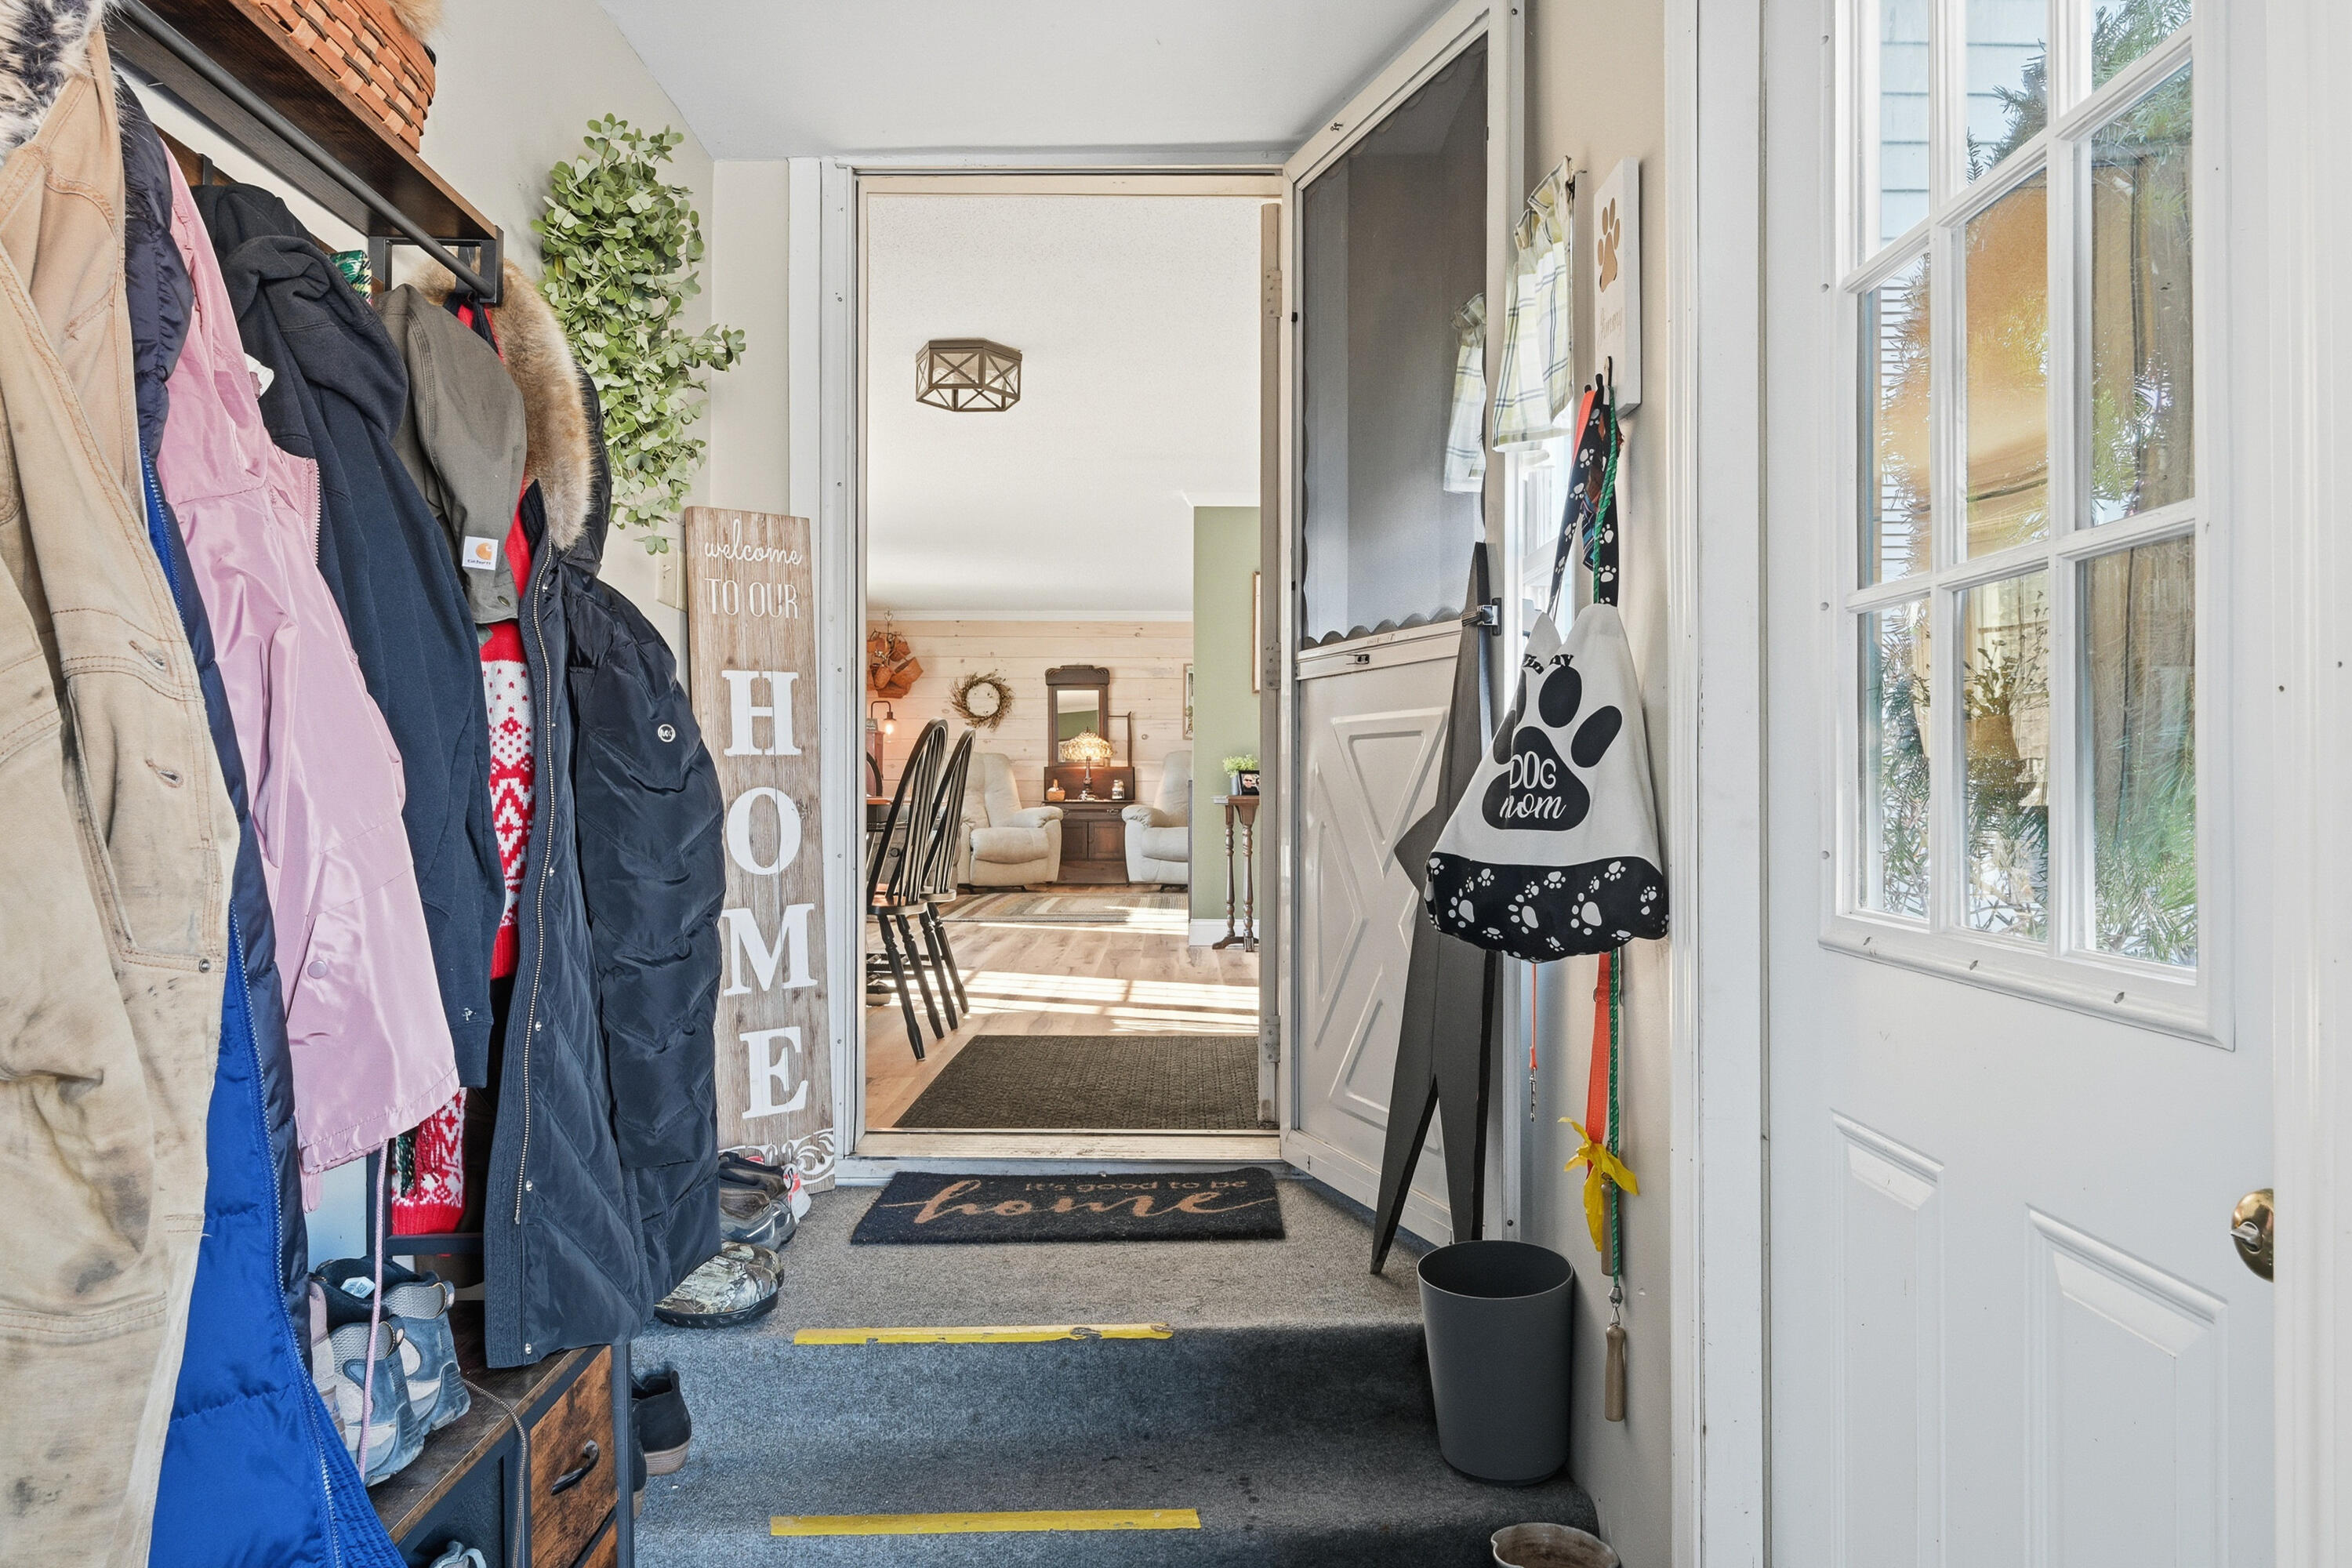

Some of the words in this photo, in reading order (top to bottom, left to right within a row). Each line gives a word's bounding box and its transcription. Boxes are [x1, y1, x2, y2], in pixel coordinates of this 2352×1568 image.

[704, 517, 803, 565] welcome
[704, 578, 739, 615] TO
[749, 582, 800, 619] OUR
[1510, 750, 1556, 789] DOG
[720, 670, 818, 1120] HOME
[879, 1179, 1276, 1224] home
[1076, 1181, 1158, 1192] good
[1169, 1181, 1200, 1189] to
[1210, 1180, 1248, 1189] be
